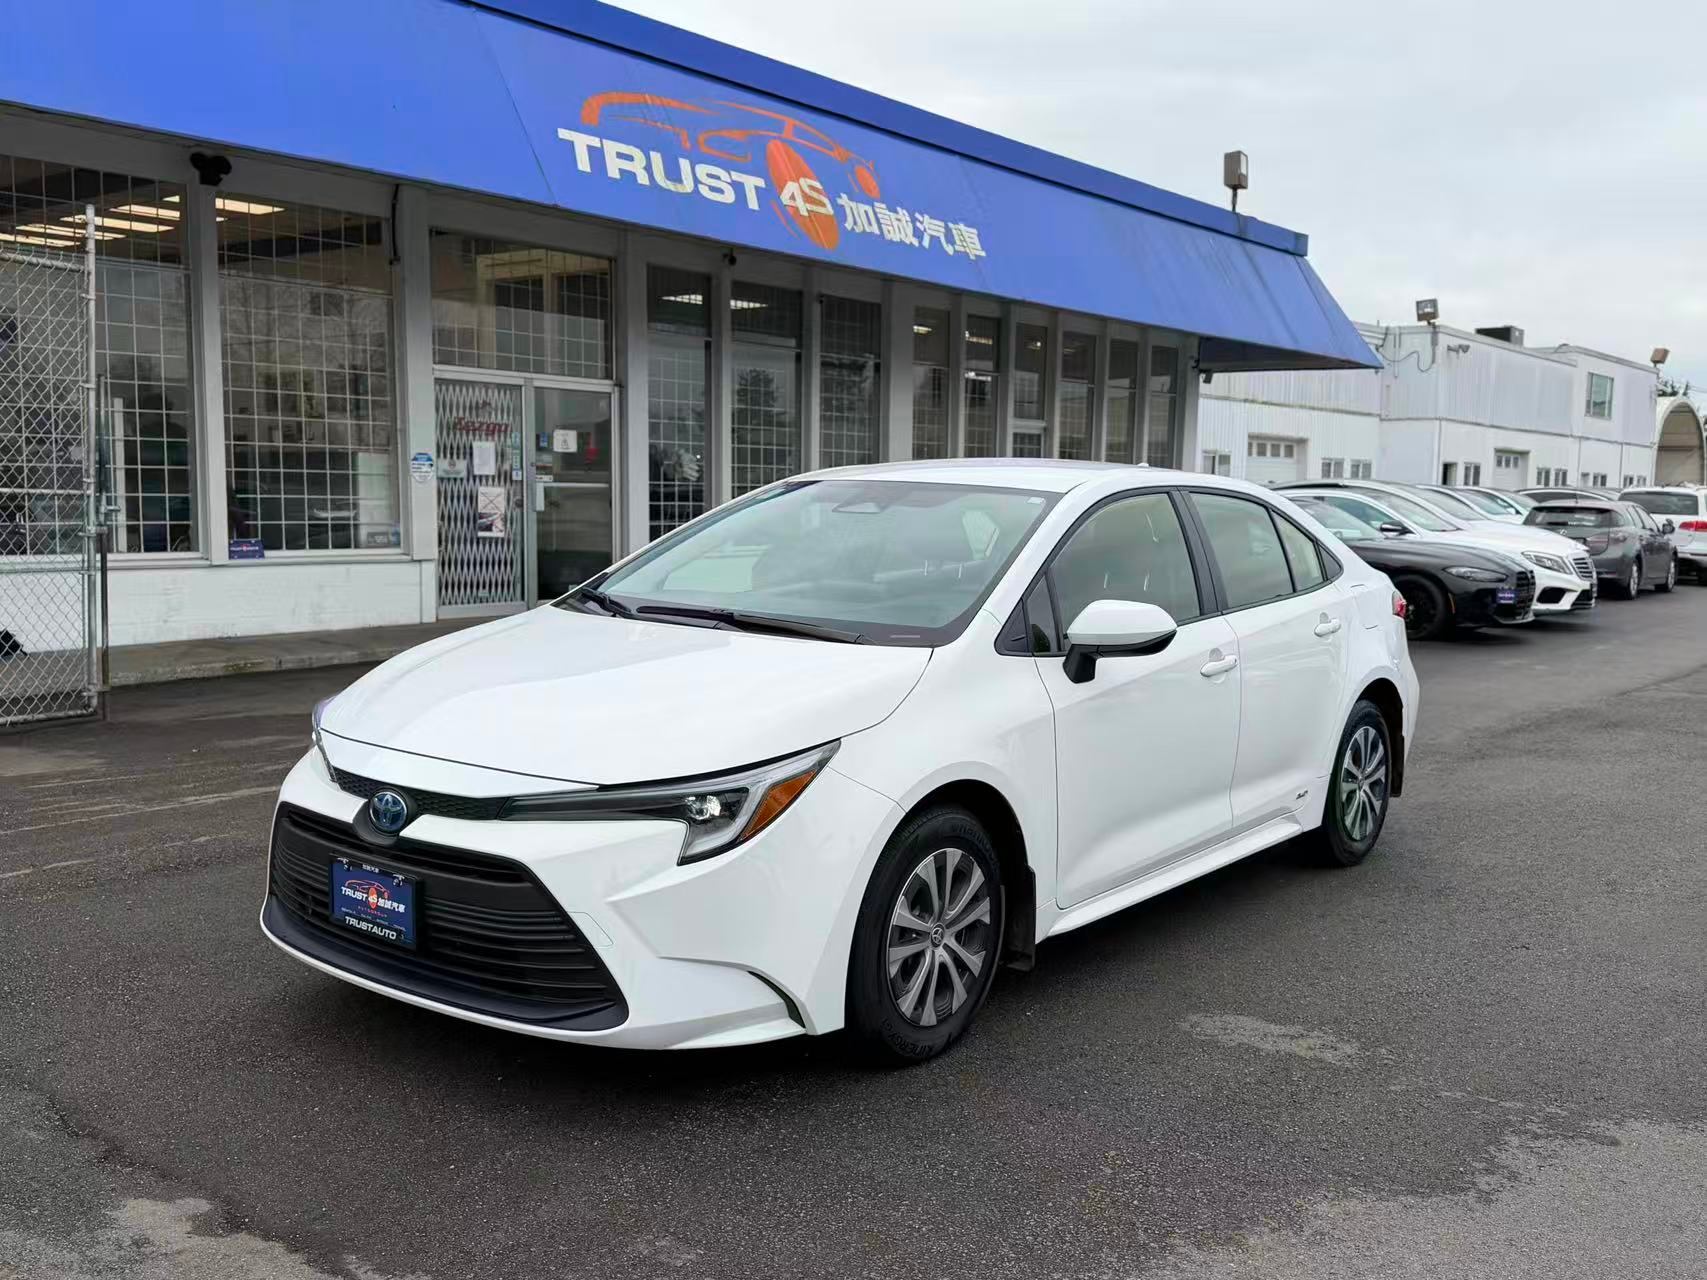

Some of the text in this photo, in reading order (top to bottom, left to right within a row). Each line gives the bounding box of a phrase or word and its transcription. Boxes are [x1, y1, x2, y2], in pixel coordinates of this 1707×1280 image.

[557, 128, 986, 261] TRUST 4S 加誠汽車
[341, 886, 367, 901] TRUST
[345, 916, 396, 939] TRUSTAUTO
